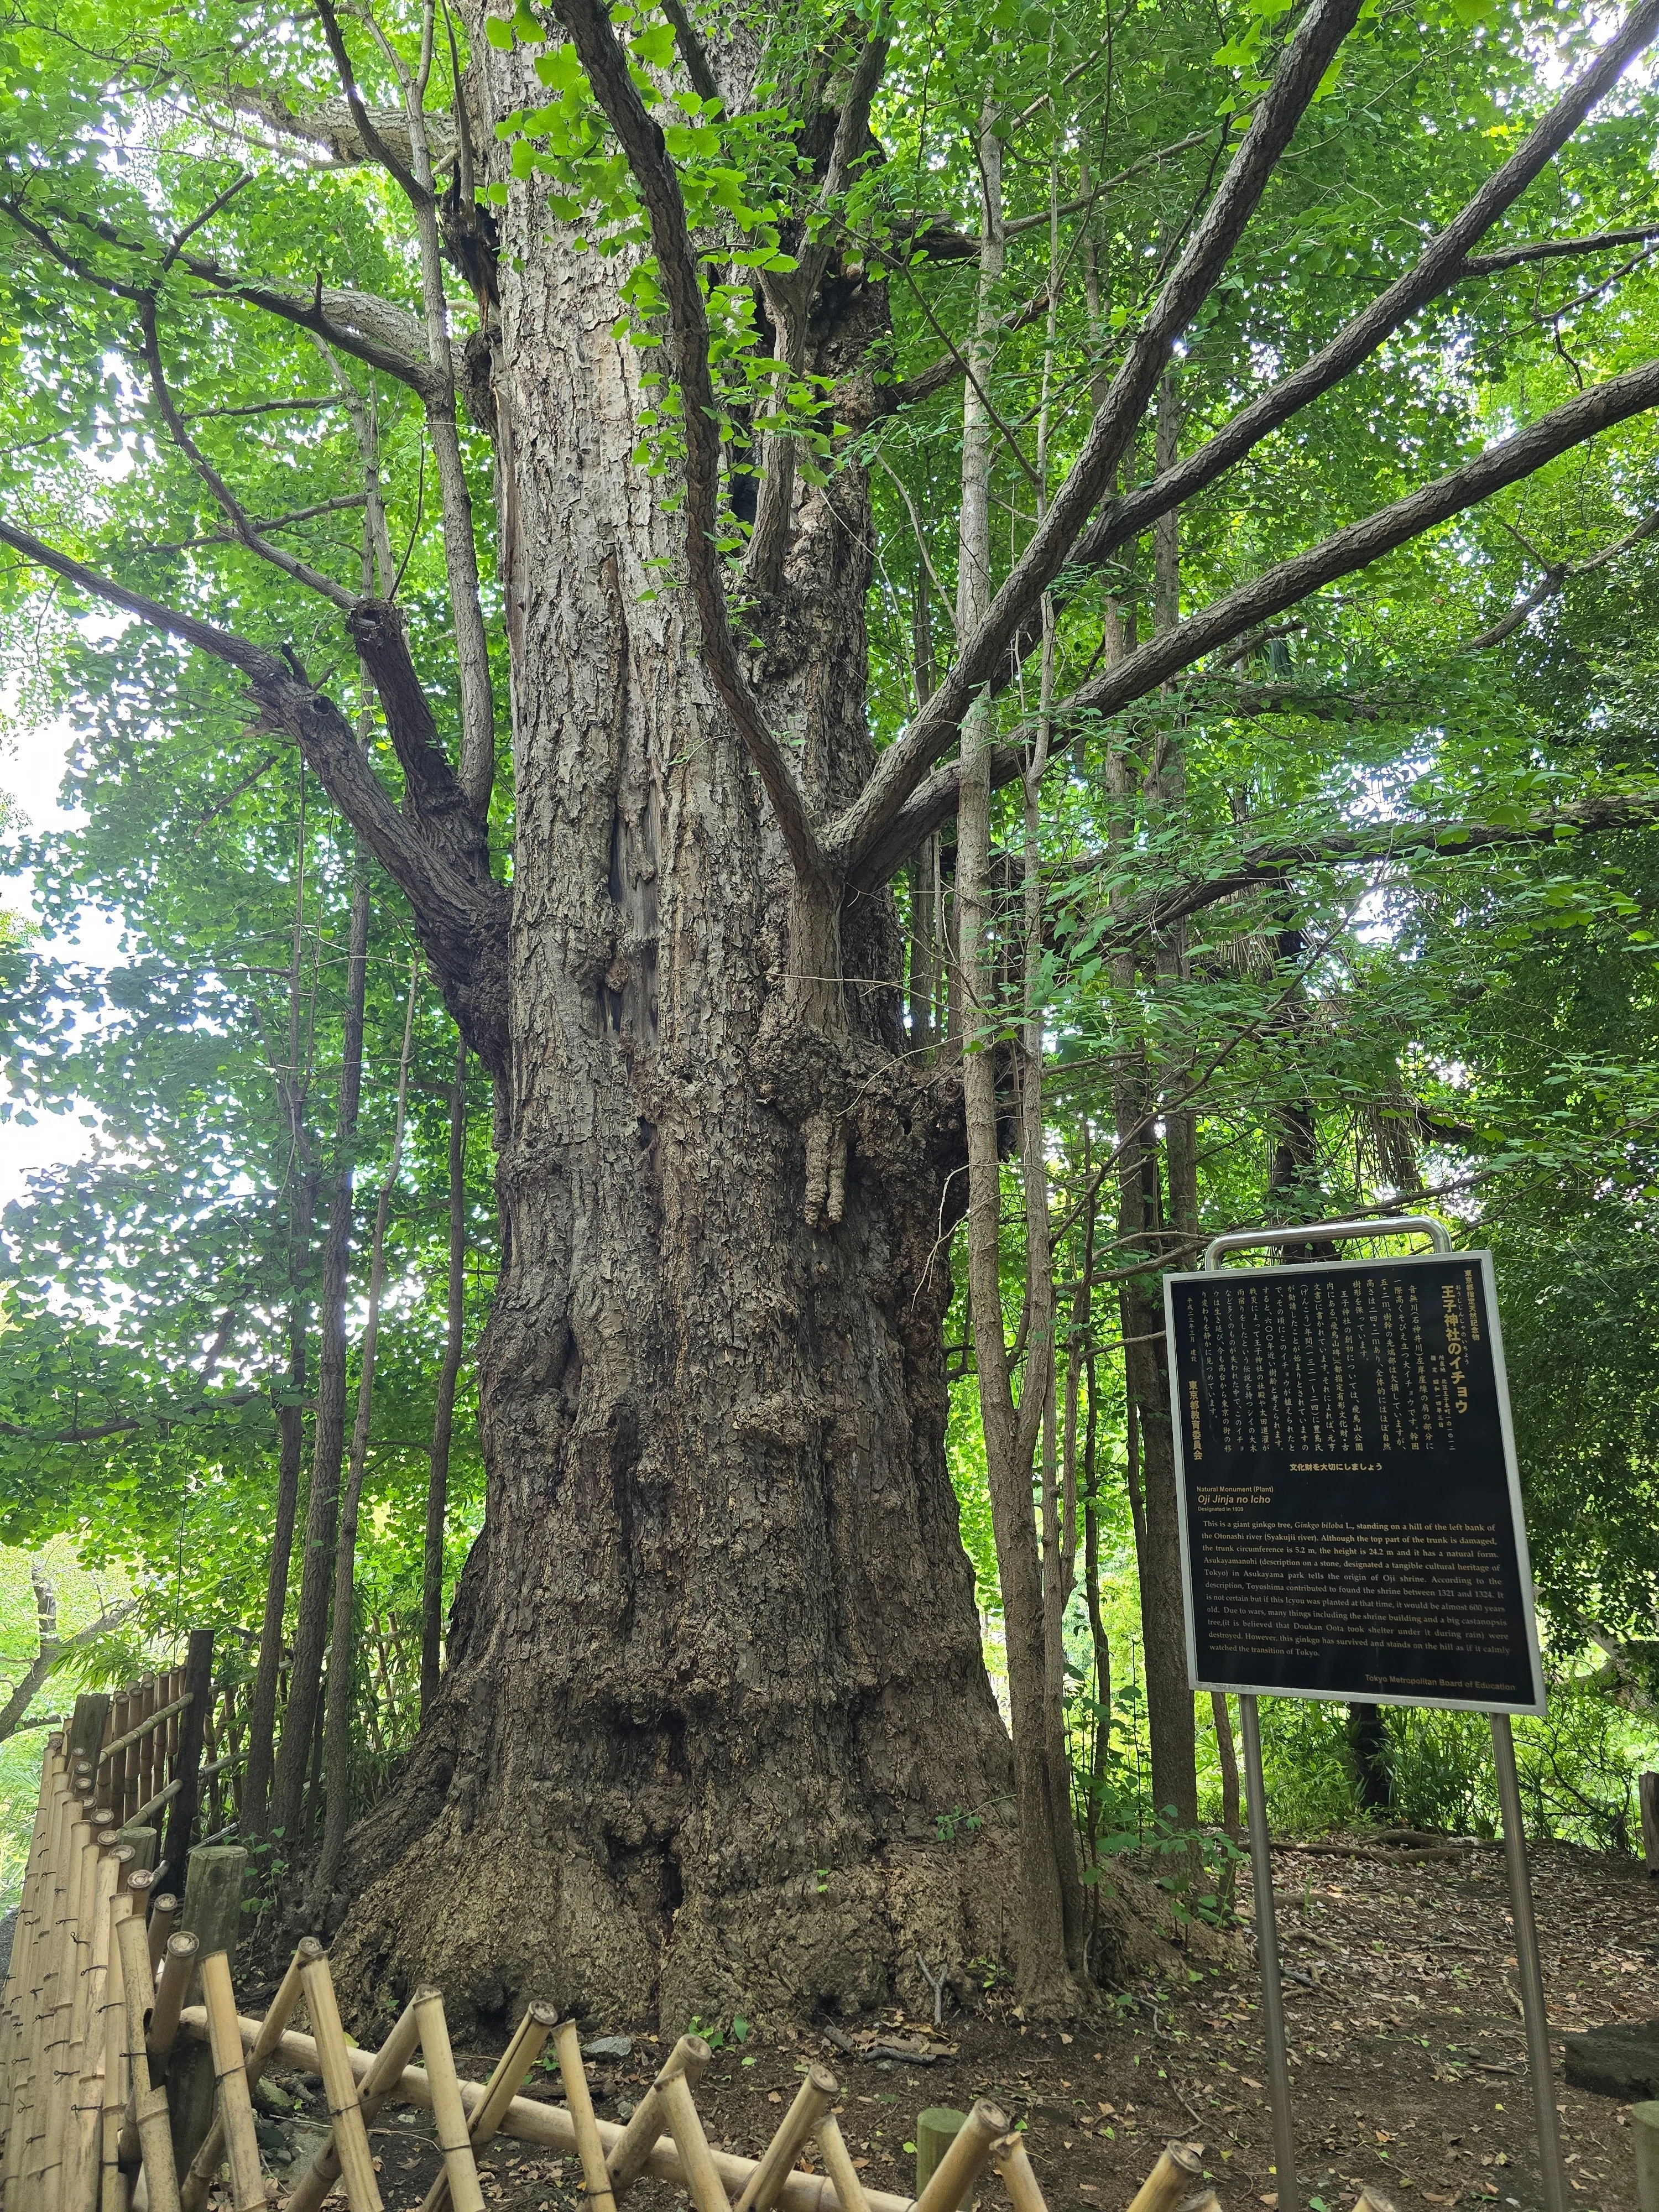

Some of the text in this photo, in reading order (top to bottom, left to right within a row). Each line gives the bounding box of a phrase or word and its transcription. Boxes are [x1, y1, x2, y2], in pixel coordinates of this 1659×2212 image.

[1352, 1280, 1369, 1360] 樹形を保っています。
[1441, 1285, 1468, 1413] 王子神社のイチョウ
[1188, 1380, 1202, 1460] 東京都教育委員会
[1289, 1463, 1382, 1471] 文化財を大切にしましょう
[1198, 1495, 1210, 1505] Oji
[1212, 1495, 1234, 1505] Jinja
[1250, 1495, 1270, 1503] Icho
[1233, 1521, 1250, 1529] giant
[1251, 1521, 1275, 1530] ginkgo
[1294, 1521, 1319, 1530] Ginkgo
[1356, 1522, 1389, 1531] standing
[1264, 1532, 1296, 1542] (Syakujii
[1321, 1534, 1355, 1543] Although
[1370, 1536, 1383, 1544] top
[1459, 1537, 1497, 1546] damaged,
[1333, 1547, 1357, 1556] height
[1259, 1558, 1300, 1567] (description
[1343, 1560, 1383, 1569] designated
[1391, 1562, 1423, 1571] tangible
[1457, 1563, 1489, 1573] heritage
[1204, 1569, 1228, 1577] Tokyo)
[1243, 1570, 1284, 1579] Asukayama
[1287, 1572, 1304, 1580] park
[1343, 1573, 1366, 1582] origin
[1383, 1574, 1395, 1583] Oji
[1431, 1575, 1472, 1585] According
[1245, 1583, 1284, 1591] Toyoshima
[1402, 1588, 1436, 1596] between
[1285, 1597, 1305, 1605] Icyou
[1322, 1598, 1349, 1606] planted
[1375, 1600, 1394, 1608] time,
[1288, 1609, 1311, 1619] things
[1313, 1610, 1348, 1620] including
[1388, 1614, 1422, 1624] building
[1446, 1616, 1460, 1625] big
[1208, 1631, 1243, 1640] destroyed.
[1245, 1633, 1277, 1641] However,
[1295, 1635, 1319, 1645] ginkgo
[1434, 1629, 1462, 1639] during
[1295, 1648, 1319, 1657] Tokyo.
[1365, 1674, 1515, 1690] Tokyo Metropolitan Board Education
